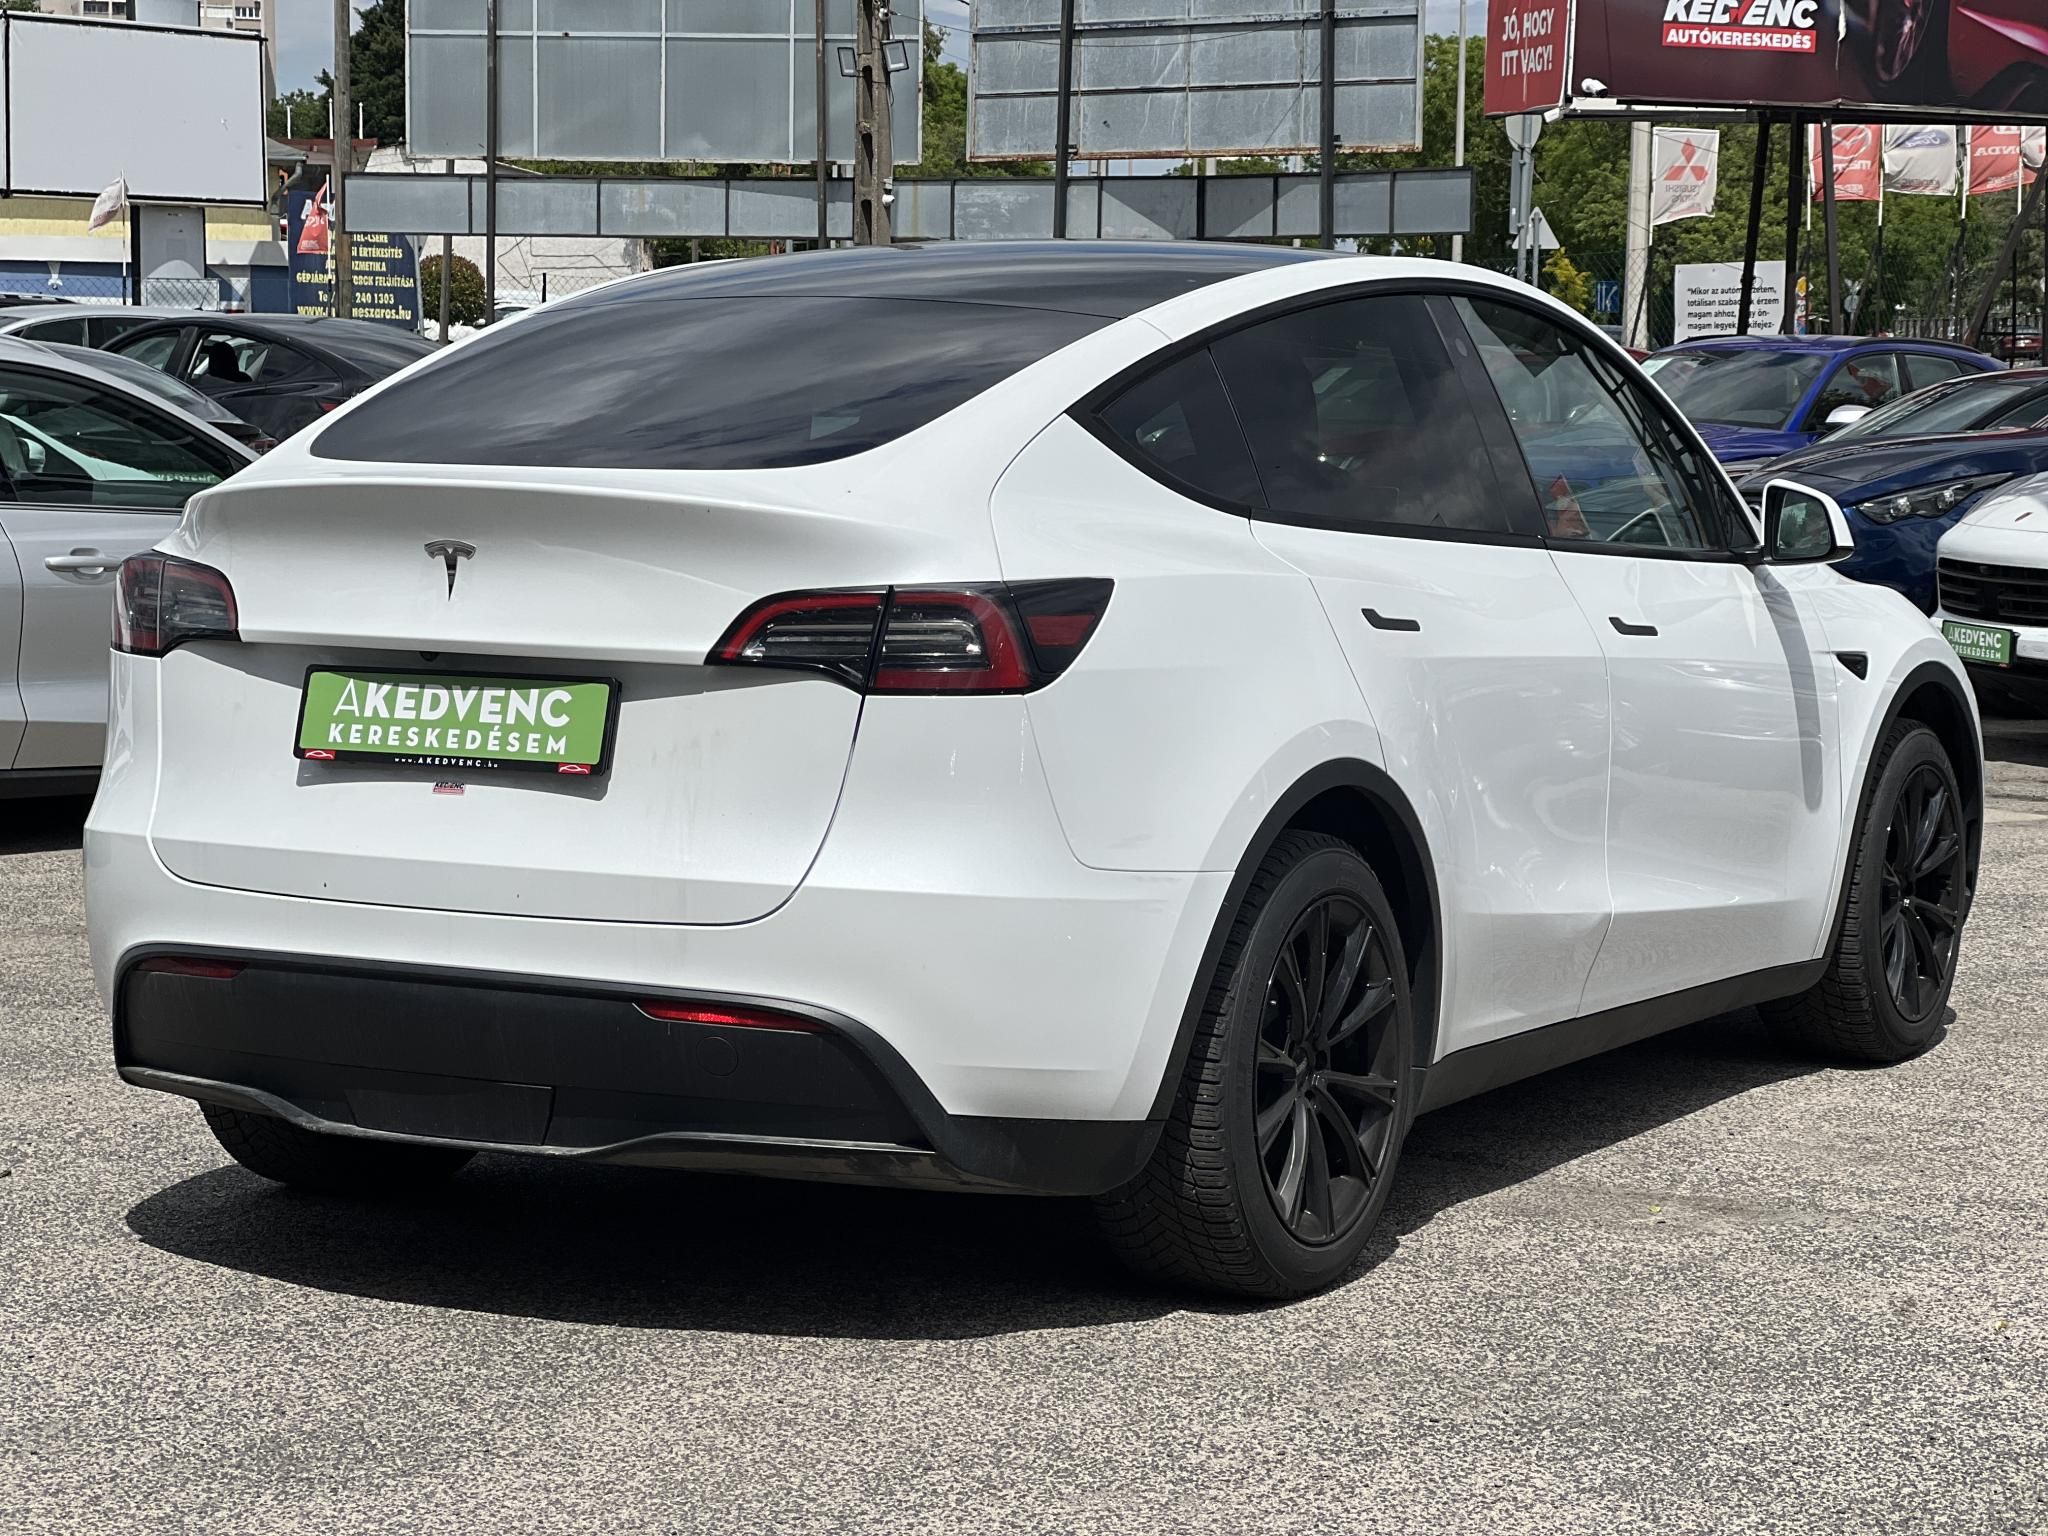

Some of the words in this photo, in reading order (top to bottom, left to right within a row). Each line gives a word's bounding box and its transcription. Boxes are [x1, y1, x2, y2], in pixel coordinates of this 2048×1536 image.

[1502, 7, 1520, 45] JÓ,
[1523, 8, 1555, 38] HOGY
[1667, 27, 1811, 49] AUTÓKERESKEDÉS
[1502, 49, 1519, 77] ITT
[1521, 44, 1553, 74] VAGY!
[359, 245, 403, 259] ÉRTÉKESÍTÉS
[355, 292, 372, 304] 240
[374, 293, 395, 304] 1303
[1688, 298, 1716, 306] totálisan
[1714, 309, 1736, 318] ahhoz,
[1688, 323, 1712, 331] magam
[1714, 321, 1737, 330] legyek
[328, 723, 567, 755] KERESKEDÉSEM
[395, 757, 498, 768] www.AKEDVENC.hu
